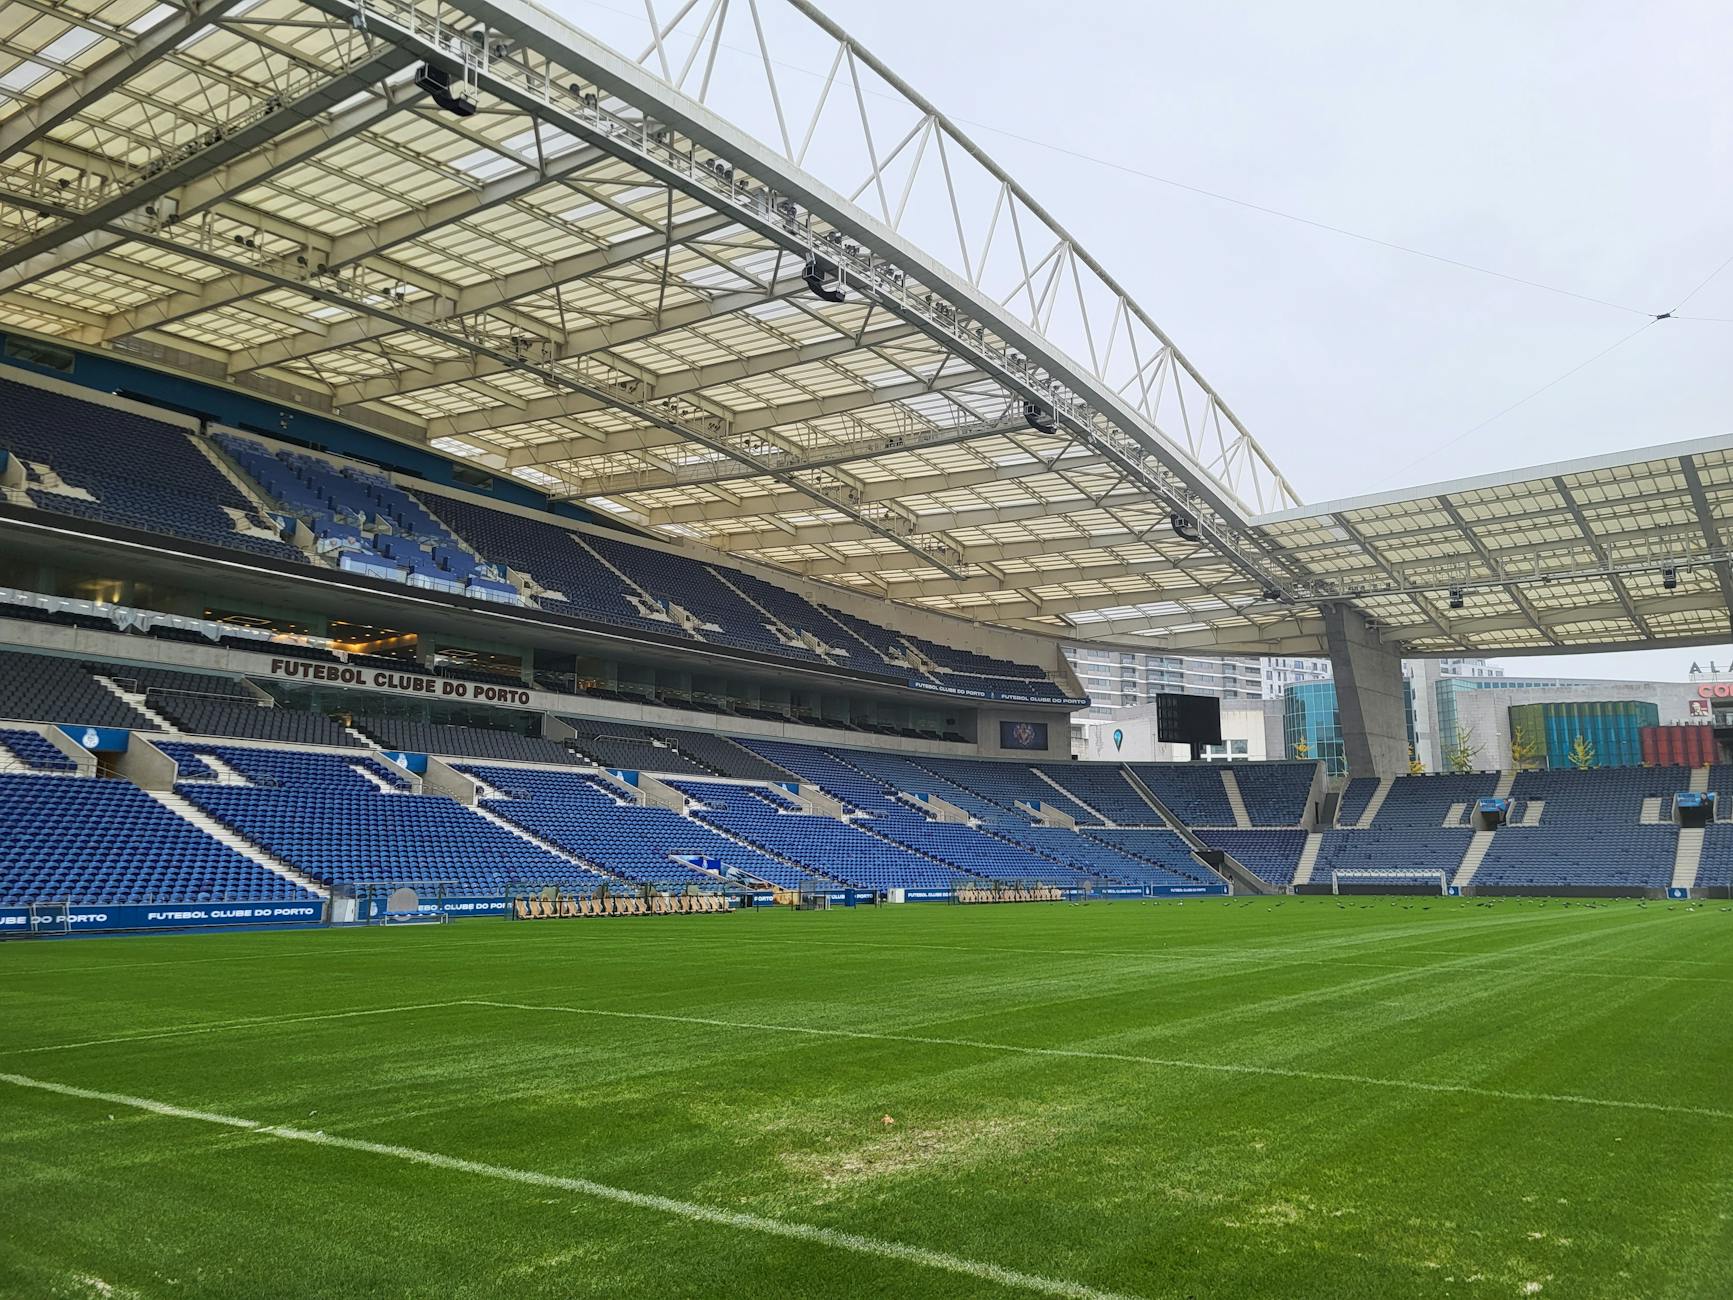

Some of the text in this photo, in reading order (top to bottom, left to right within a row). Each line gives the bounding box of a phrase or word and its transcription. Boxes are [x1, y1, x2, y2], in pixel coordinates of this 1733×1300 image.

[271, 658, 530, 704] FUTEBOL CLUBE DO PORTO
[915, 682, 939, 690] FUTEBOL
[1698, 684, 1733, 698] CO
[31, 915, 53, 923] DO
[56, 914, 107, 923] PORTO
[148, 908, 314, 920] FUTEBOL CLUBE DO PORTO
